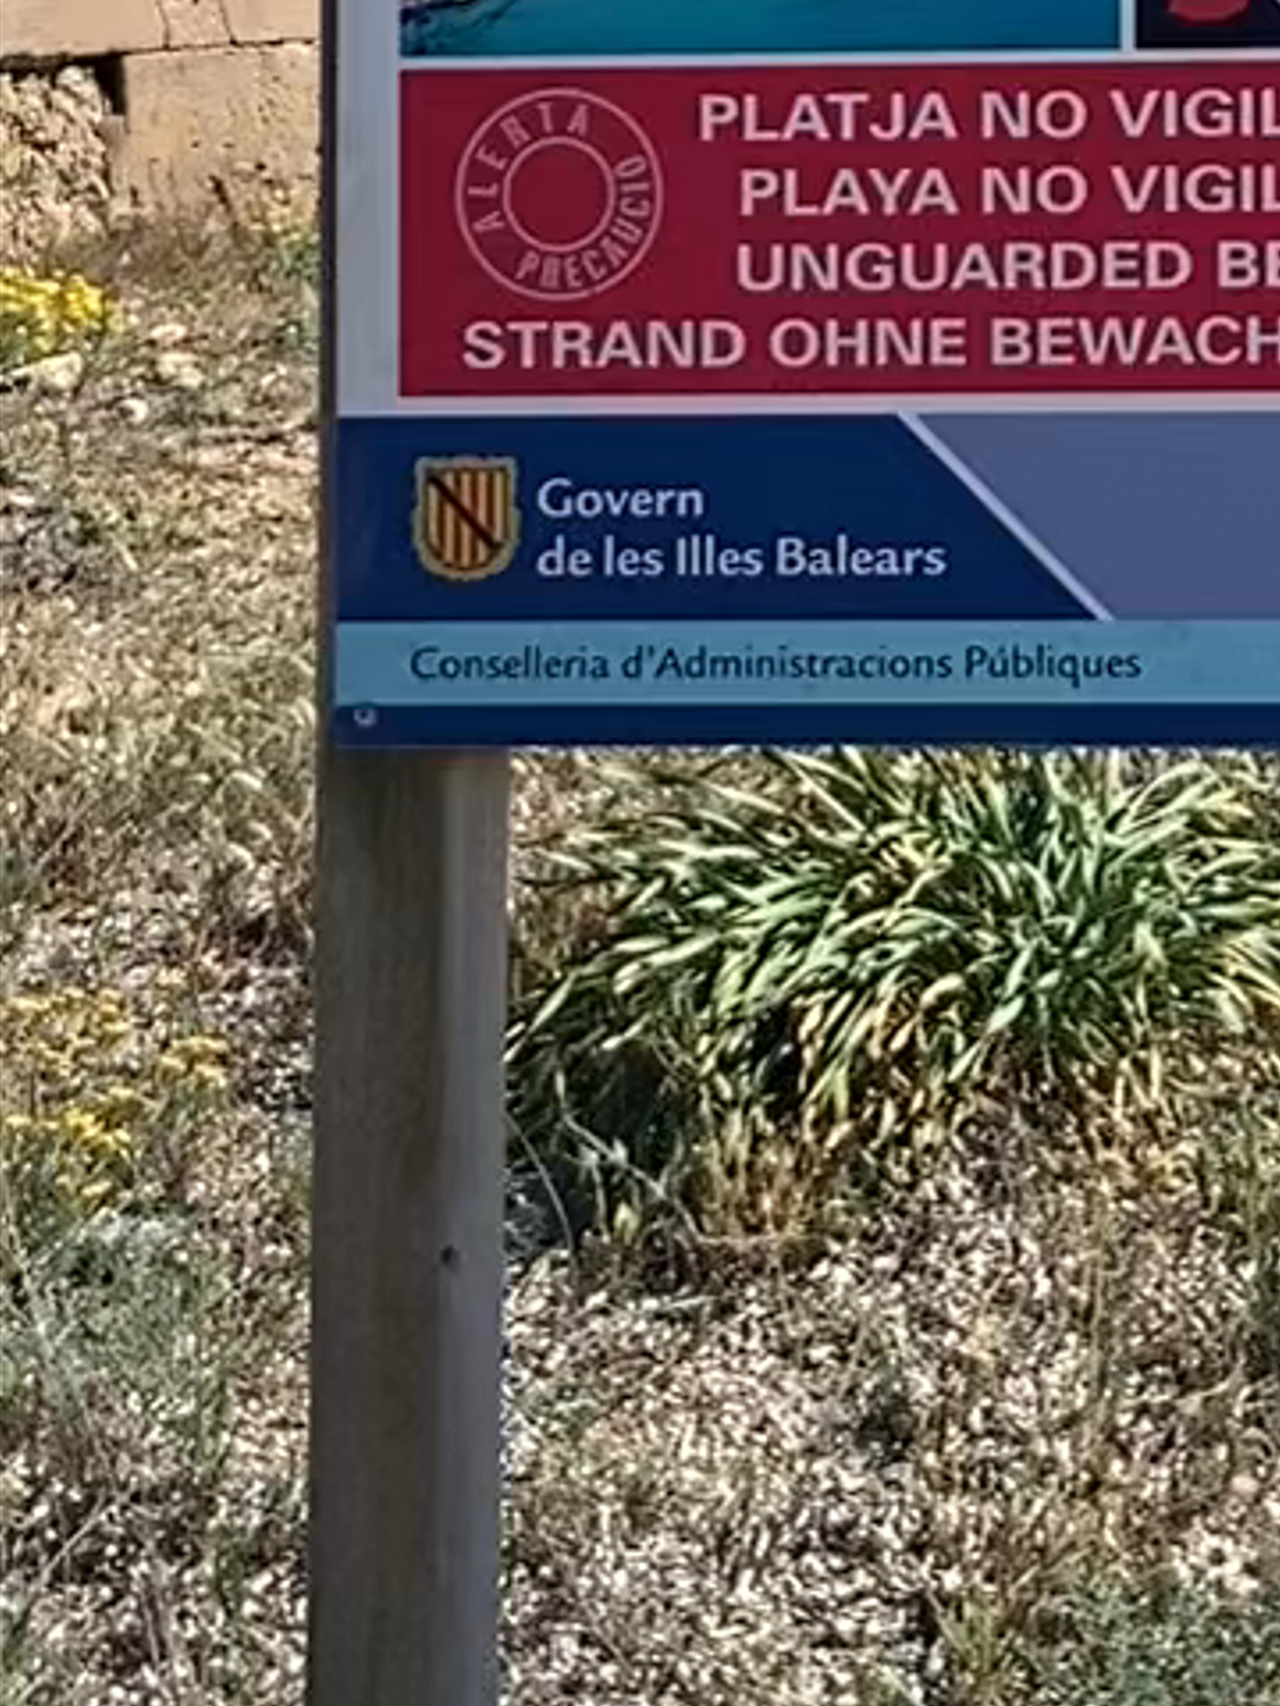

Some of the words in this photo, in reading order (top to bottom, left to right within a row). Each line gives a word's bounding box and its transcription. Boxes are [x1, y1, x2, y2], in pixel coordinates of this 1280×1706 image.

[700, 91, 959, 143] PLATJA
[980, 89, 1088, 140] NO
[472, 101, 590, 234] ALERTA
[740, 166, 960, 217] PLAYA
[981, 164, 1088, 215] NO
[736, 240, 1193, 292] UNGUARDED
[462, 319, 747, 370] STRAND
[768, 317, 968, 368] OHNE
[536, 476, 705, 519] Govern
[535, 533, 594, 577] de
[603, 533, 664, 577] les
[675, 533, 764, 577] Illes
[775, 532, 948, 577] Balears
[409, 644, 612, 683] Conselleria
[619, 643, 954, 681] d'Administracions
[963, 642, 1143, 690] Públiques
